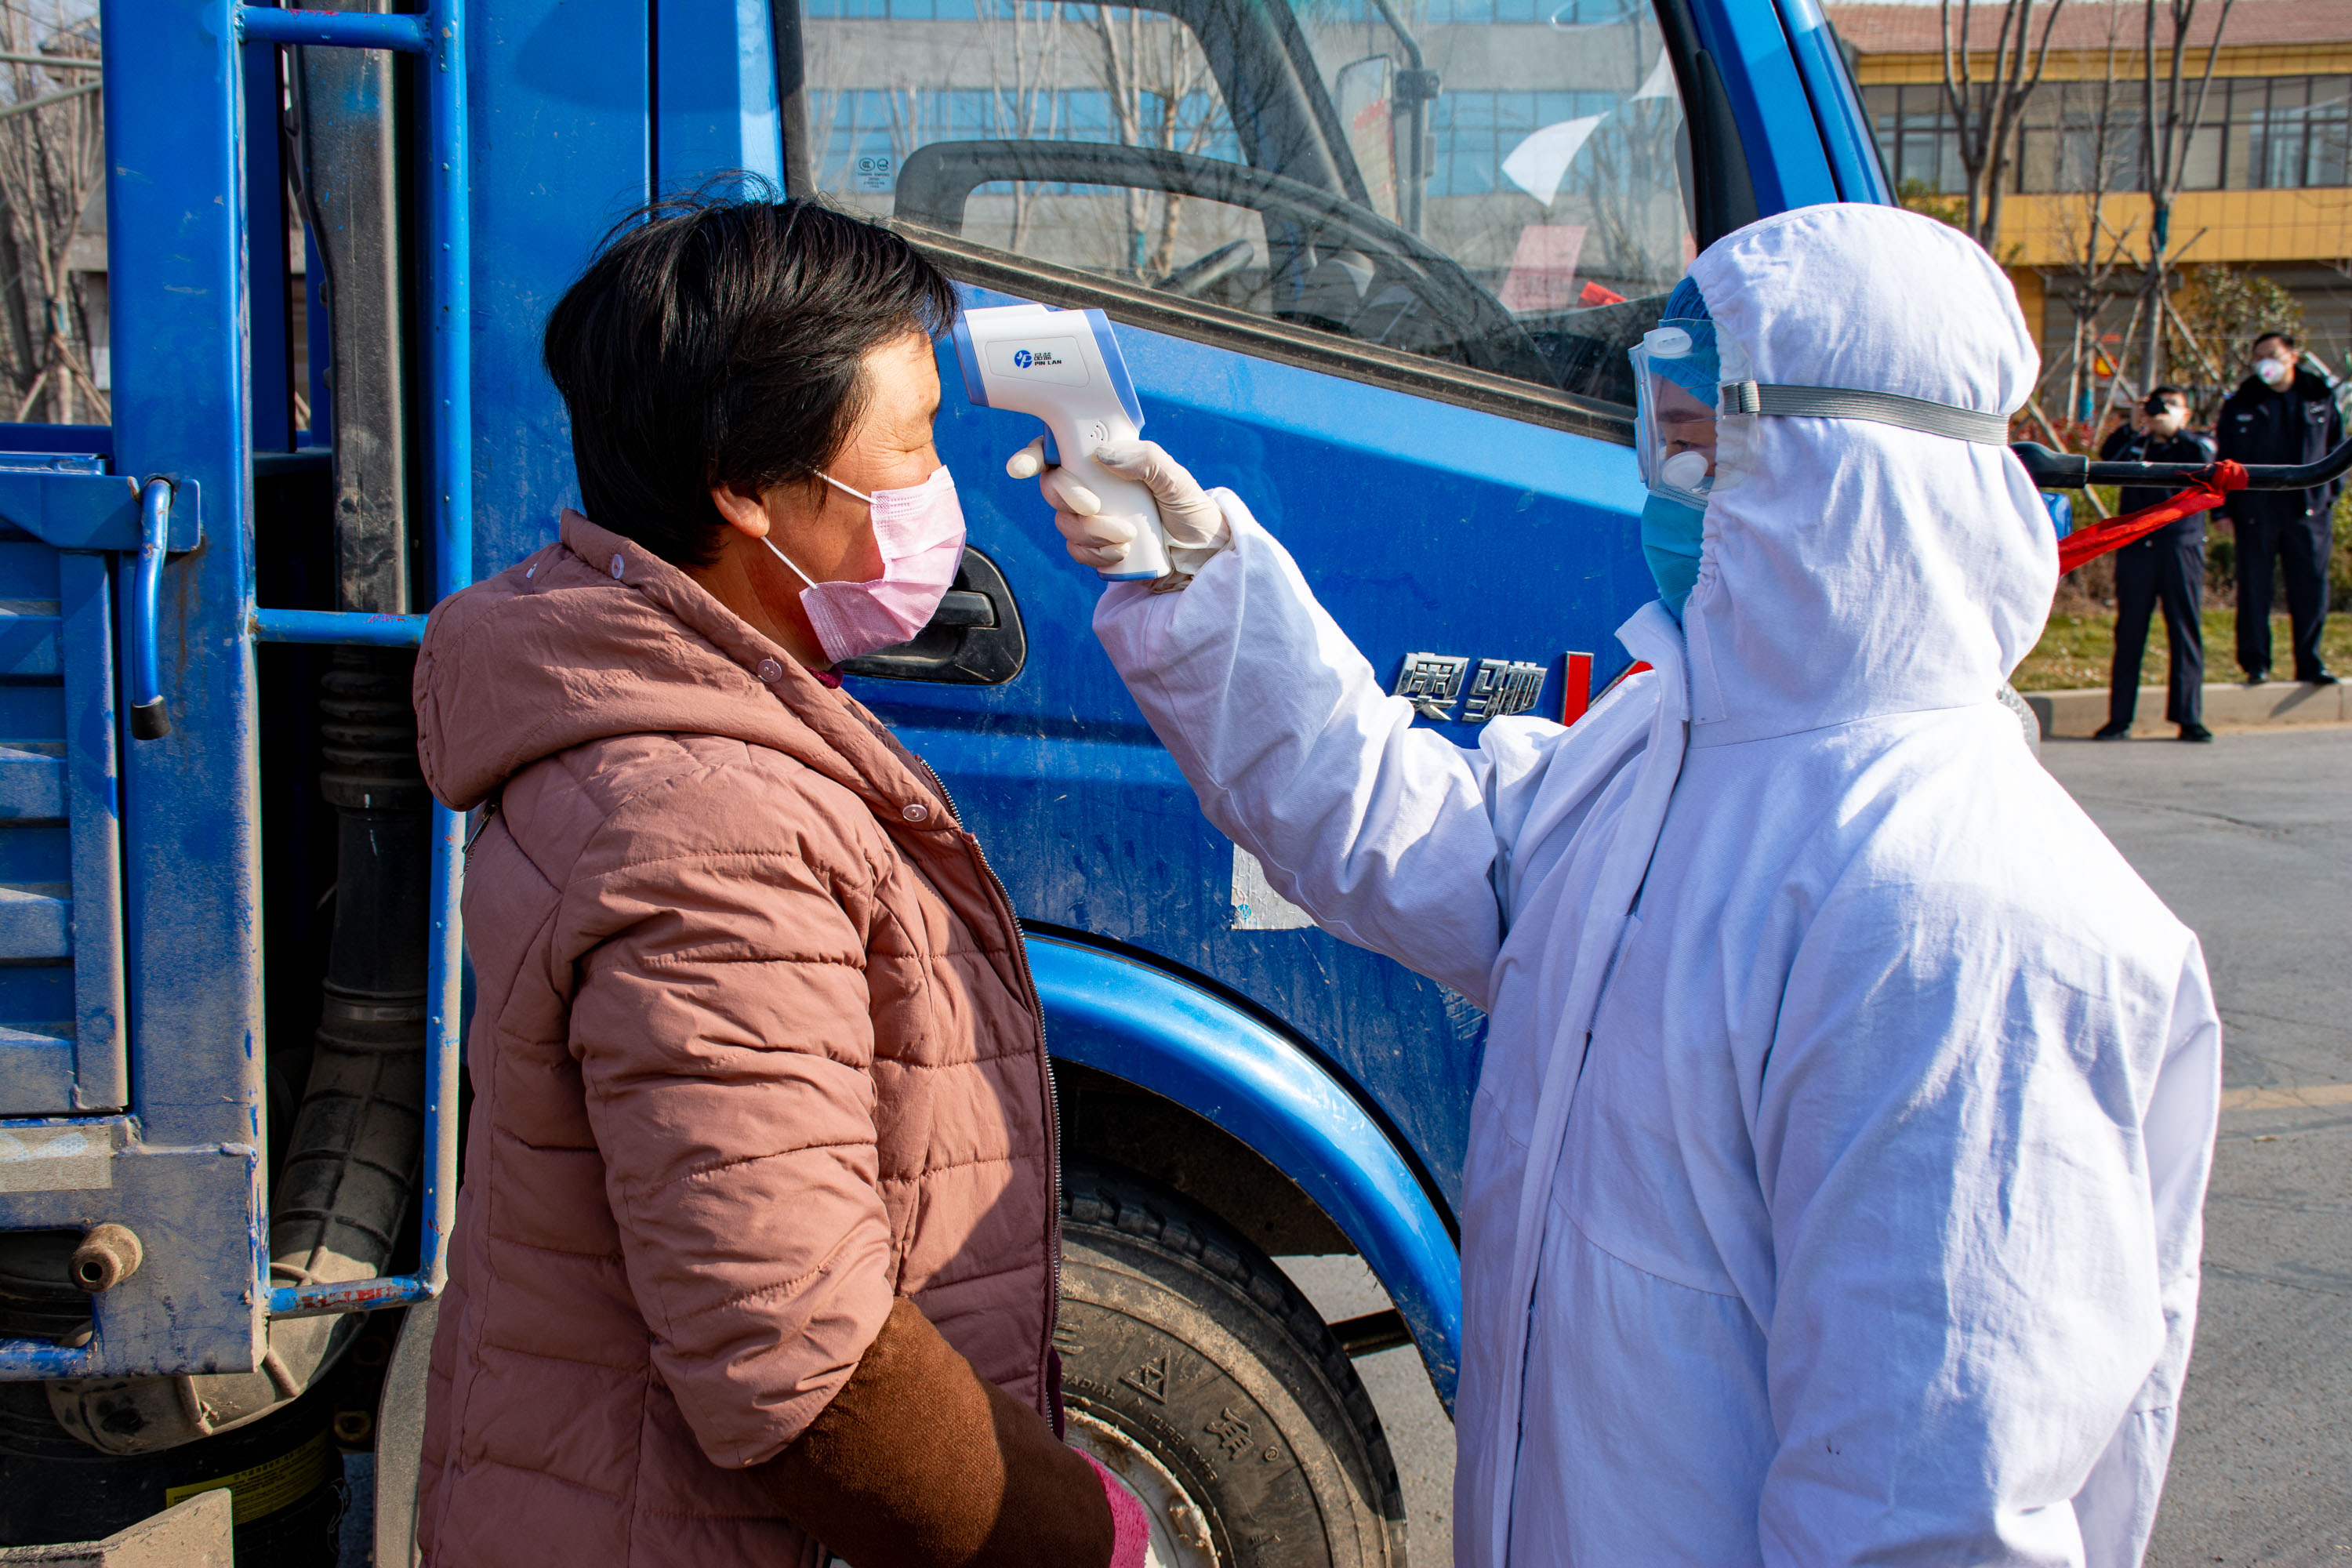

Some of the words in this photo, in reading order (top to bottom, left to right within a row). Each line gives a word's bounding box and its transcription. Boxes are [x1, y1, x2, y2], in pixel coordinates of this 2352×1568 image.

[1034, 352, 1051, 361] 品蓝
[1395, 652, 1548, 722] 奥驰
[1148, 1414, 1185, 1444] TUBE
